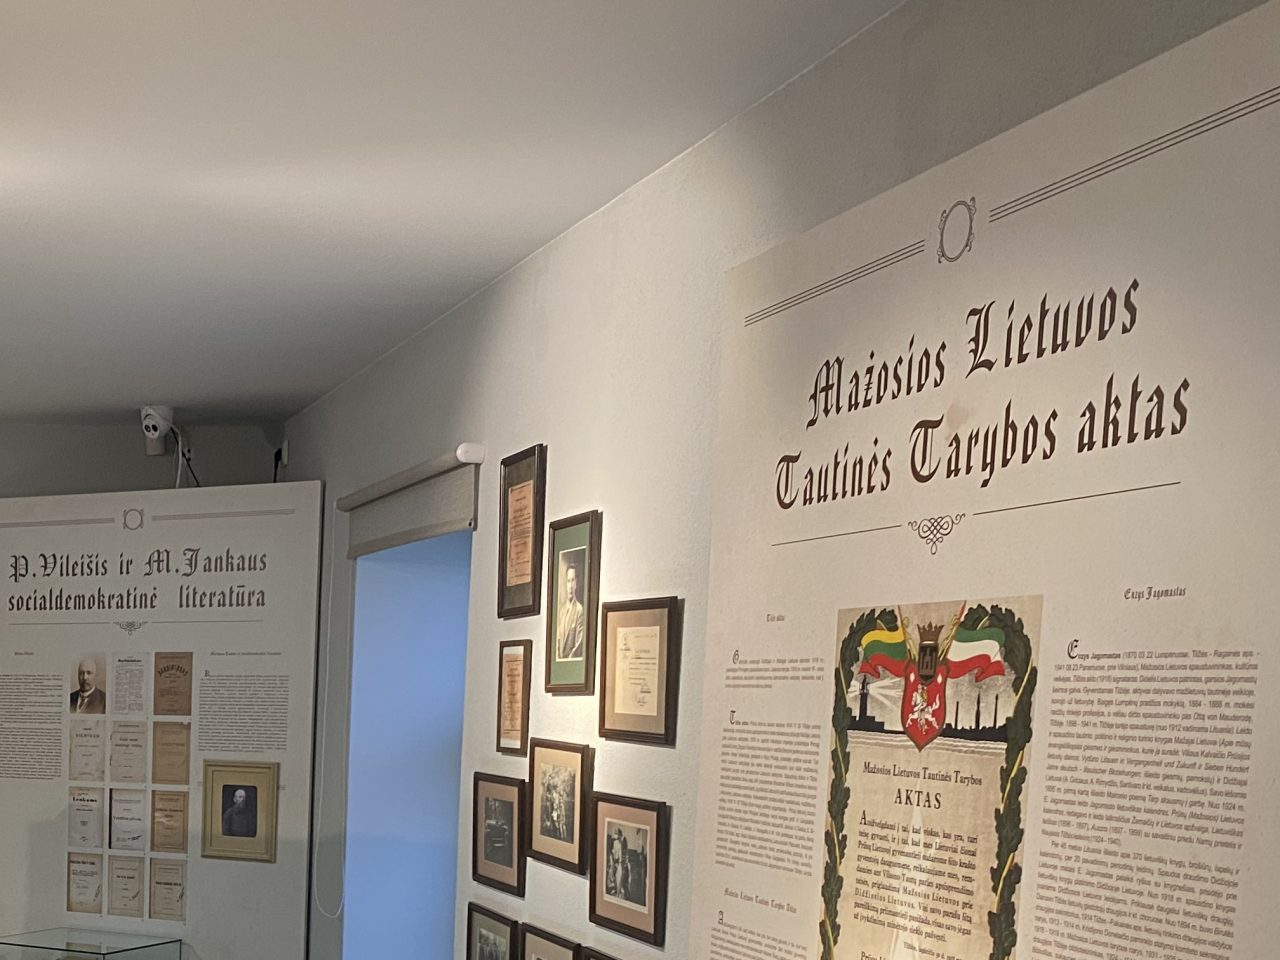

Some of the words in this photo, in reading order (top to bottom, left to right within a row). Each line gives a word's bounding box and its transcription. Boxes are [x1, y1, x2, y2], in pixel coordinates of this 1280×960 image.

[965, 278, 1140, 379] Lietuvos
[775, 436, 893, 511] Tautinės
[909, 398, 1059, 488] Tarybos
[1077, 371, 1191, 454] aktas
[120, 552, 133, 576] ir
[8, 586, 157, 611] socialdemokratinė
[179, 584, 266, 609] literatūra
[894, 788, 942, 809] AKTAS
